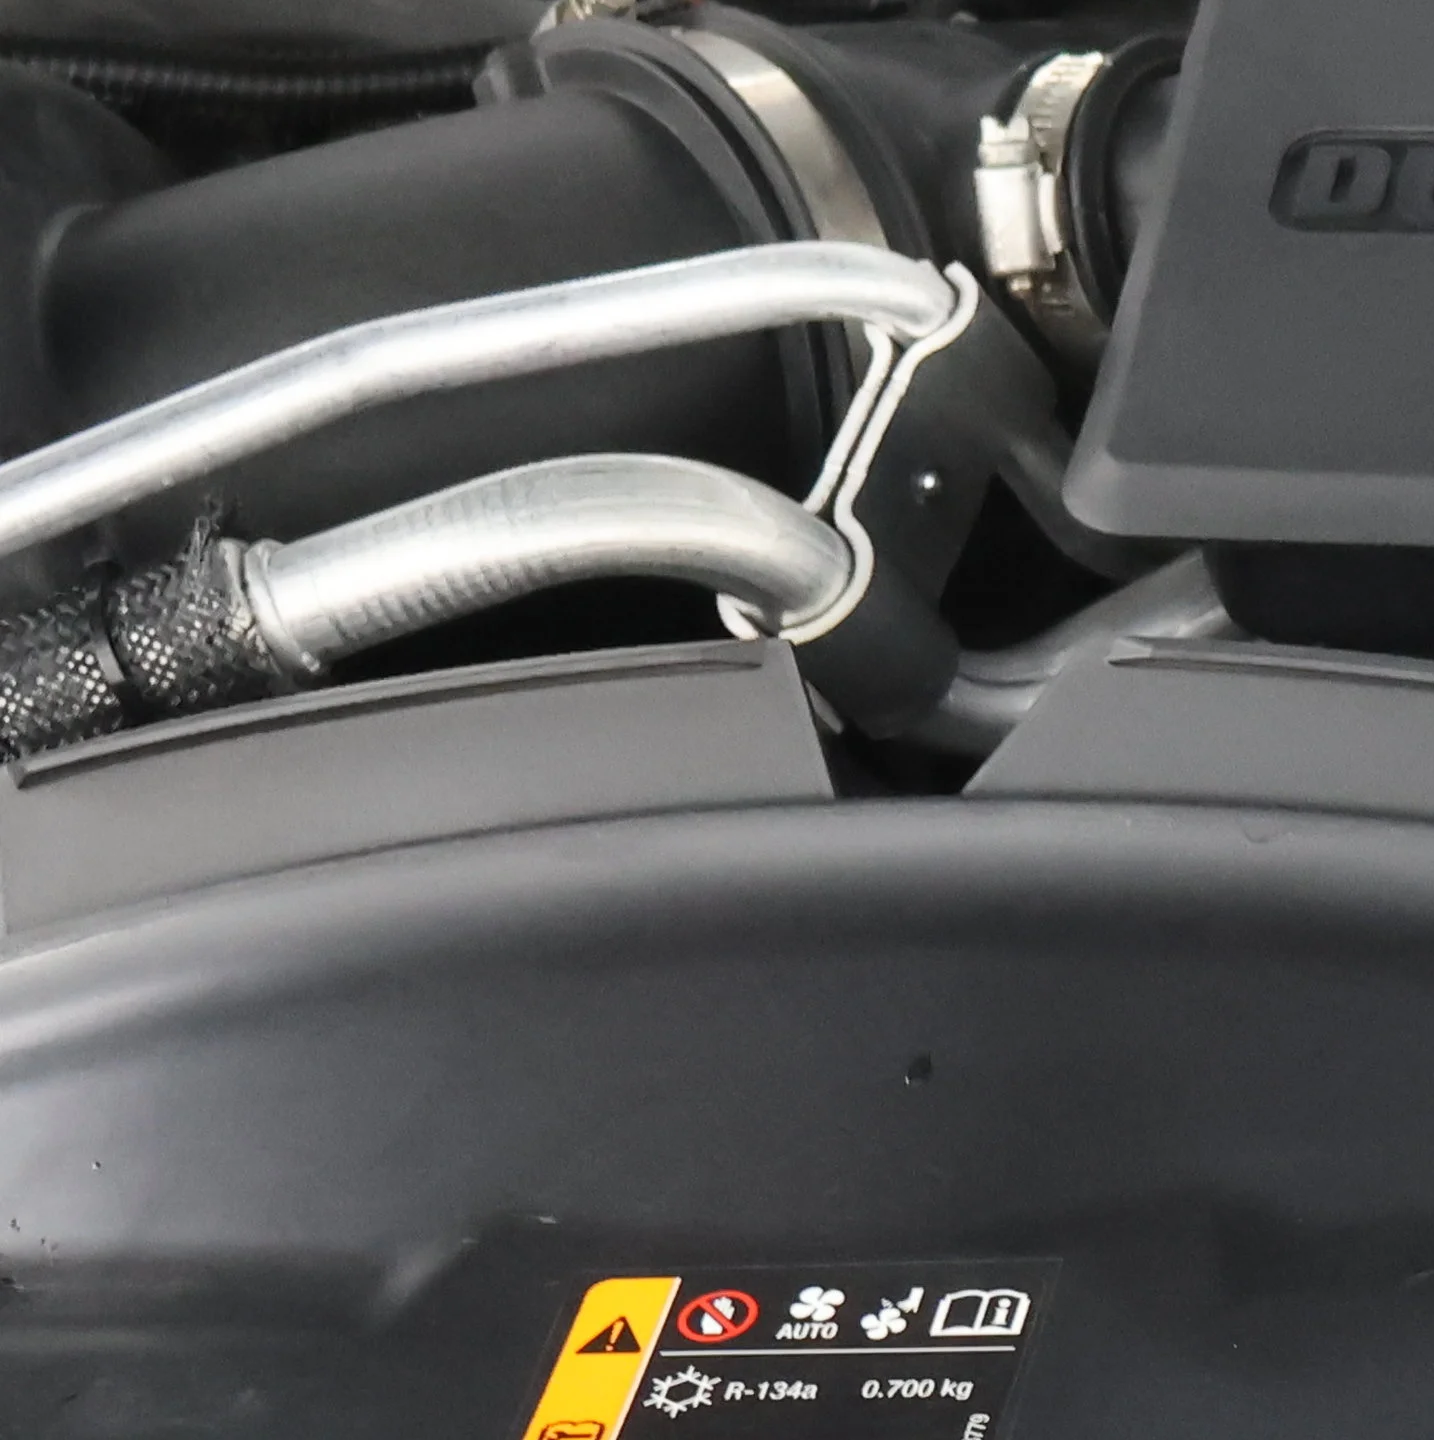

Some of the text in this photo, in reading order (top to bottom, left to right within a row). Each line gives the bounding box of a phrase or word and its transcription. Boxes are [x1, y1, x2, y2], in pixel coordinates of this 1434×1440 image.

[775, 1322, 839, 1340] AUTO
[723, 1378, 974, 1401] R-134a 0.700 kg
